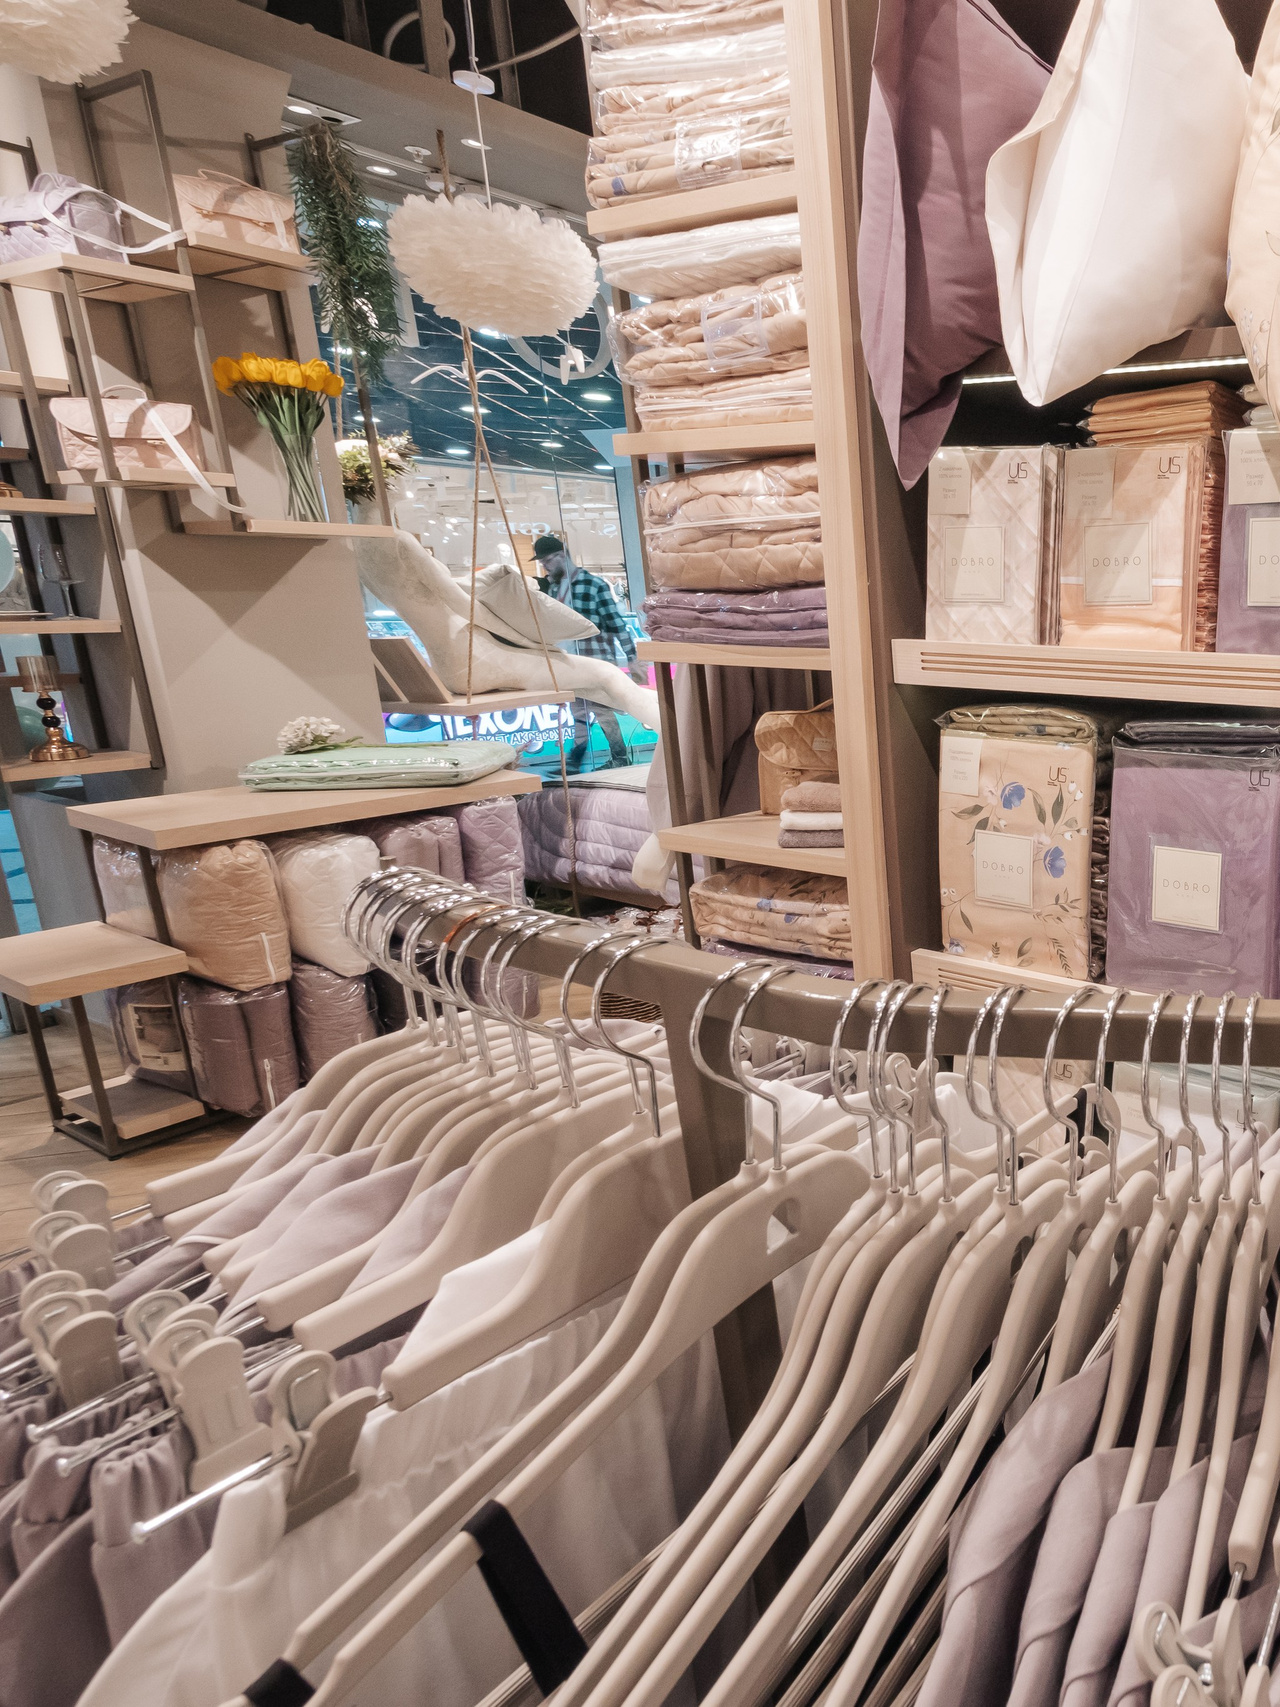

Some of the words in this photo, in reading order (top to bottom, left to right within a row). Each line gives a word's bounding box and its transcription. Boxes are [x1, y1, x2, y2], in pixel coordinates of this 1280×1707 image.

[1008, 461, 1028, 479] US
[1158, 456, 1181, 474] US
[951, 557, 995, 567] DOBRO
[1092, 556, 1142, 568] DOBRO
[982, 860, 1024, 875] DOBRO
[1162, 878, 1211, 894] DOBRO
